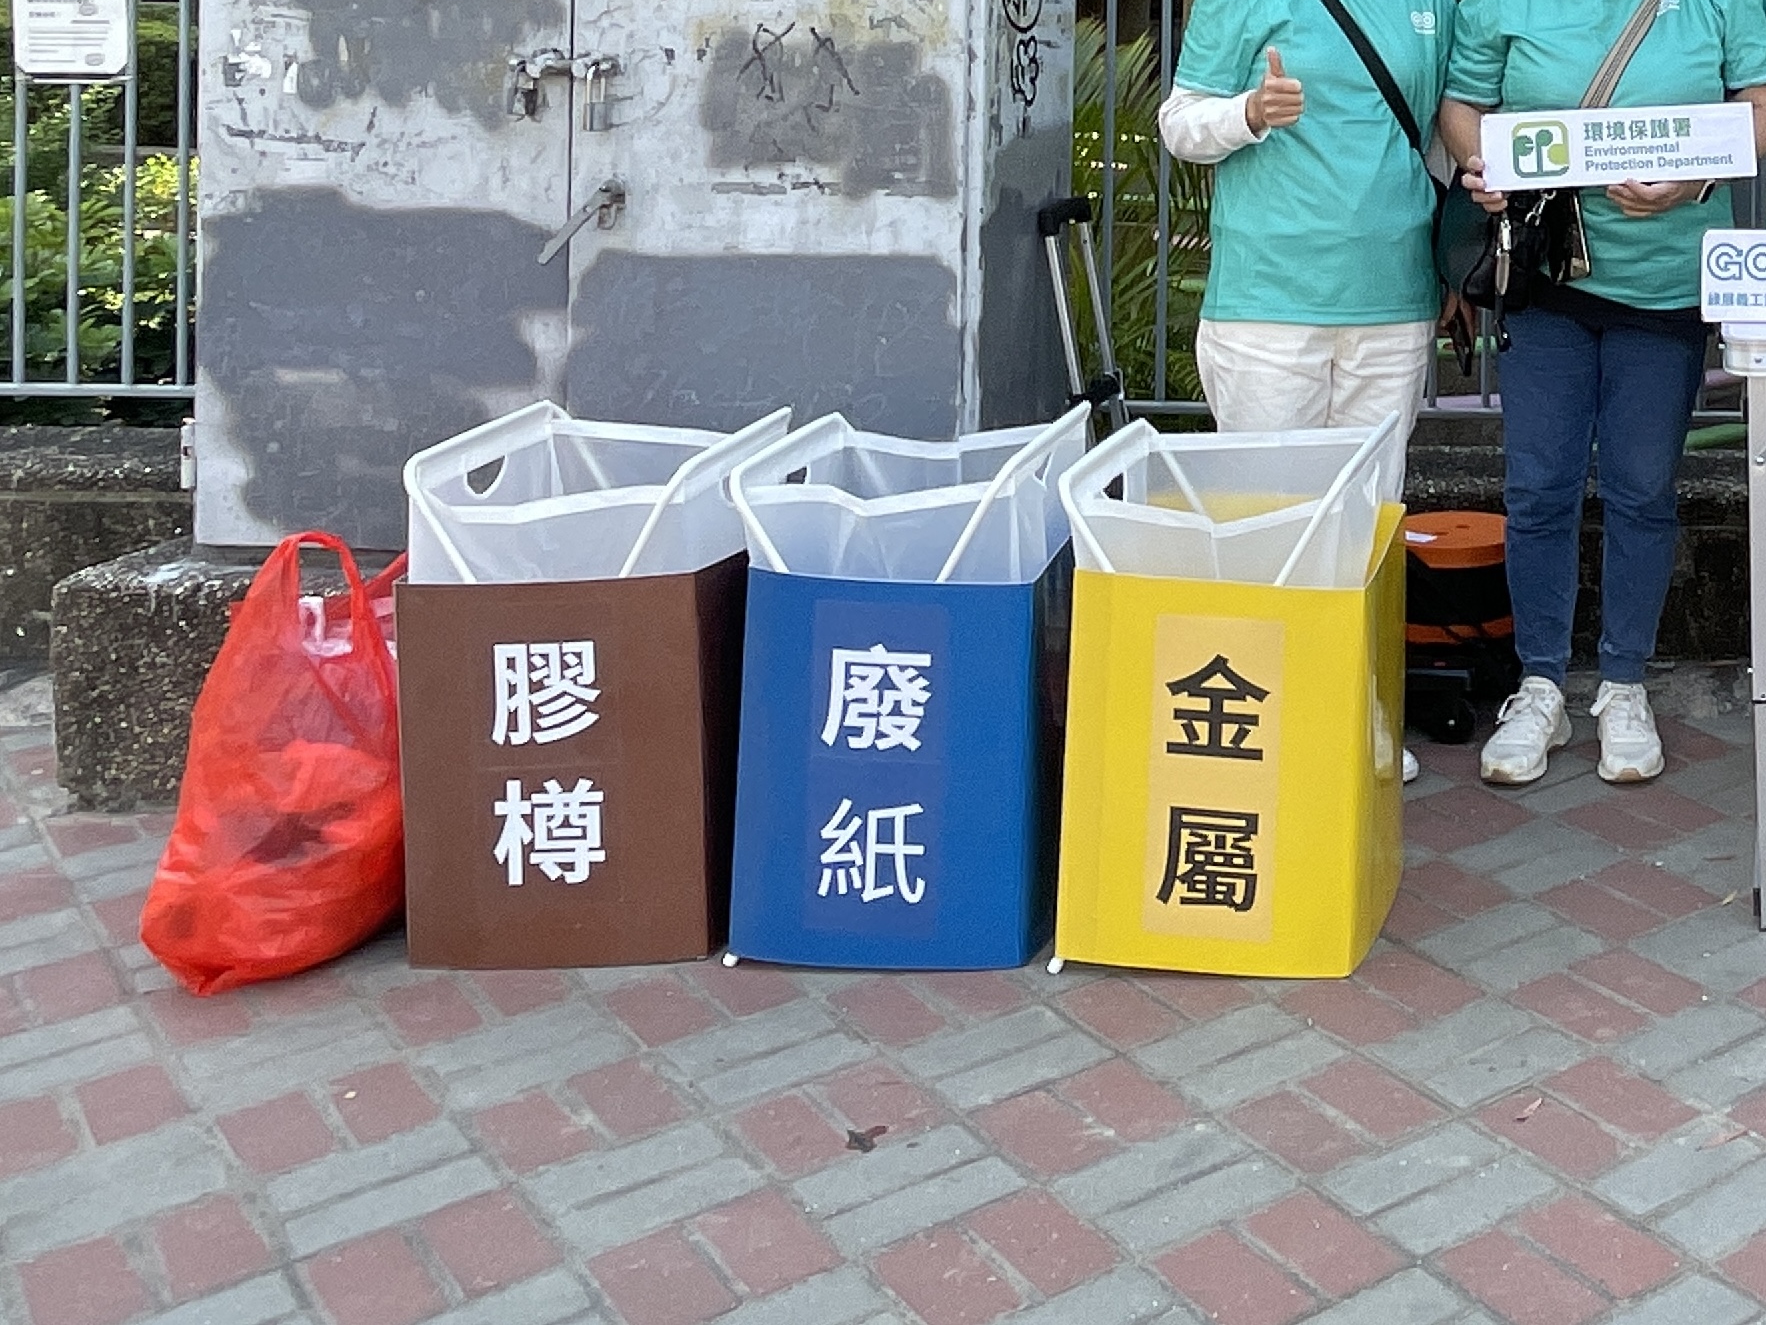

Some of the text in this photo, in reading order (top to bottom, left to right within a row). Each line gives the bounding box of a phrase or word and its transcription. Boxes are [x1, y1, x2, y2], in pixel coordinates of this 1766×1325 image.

[1583, 117, 1691, 142] 環境保護署
[1584, 142, 1680, 158] Environmental
[1584, 153, 1734, 173] Protection Department
[491, 640, 606, 886] 膠樽
[817, 643, 932, 904] 廢紙
[1156, 653, 1270, 912] 金屬
